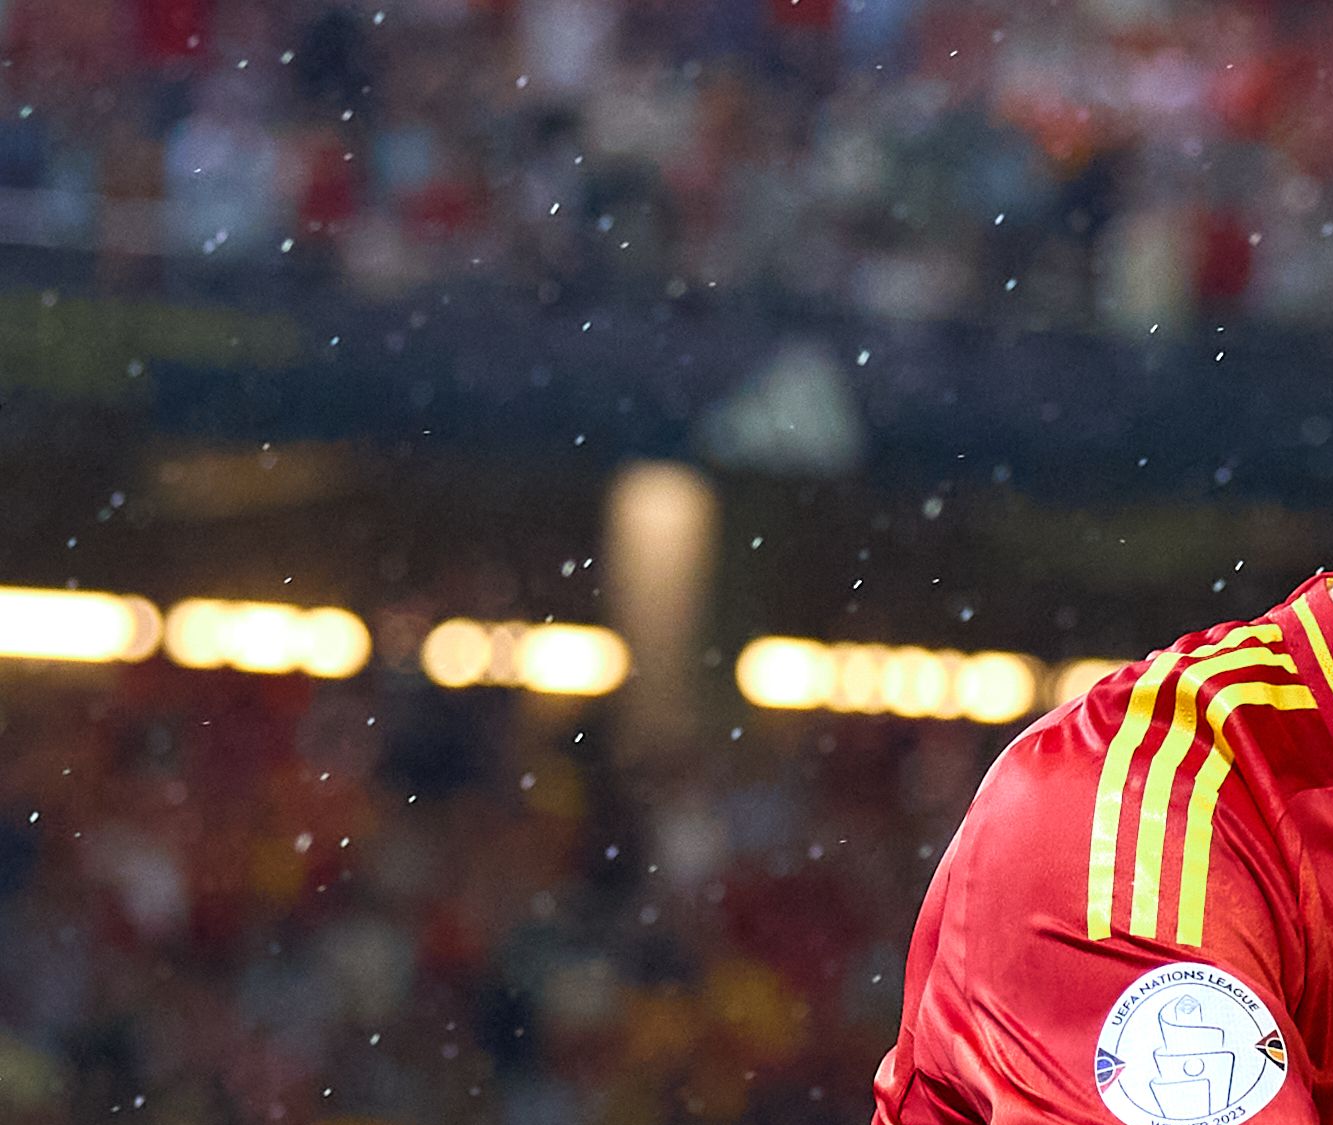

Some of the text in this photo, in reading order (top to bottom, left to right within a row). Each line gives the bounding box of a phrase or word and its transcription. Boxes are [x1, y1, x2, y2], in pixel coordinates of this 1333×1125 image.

[1111, 970, 1261, 1026] UEFA NATIONS LEAGUE
